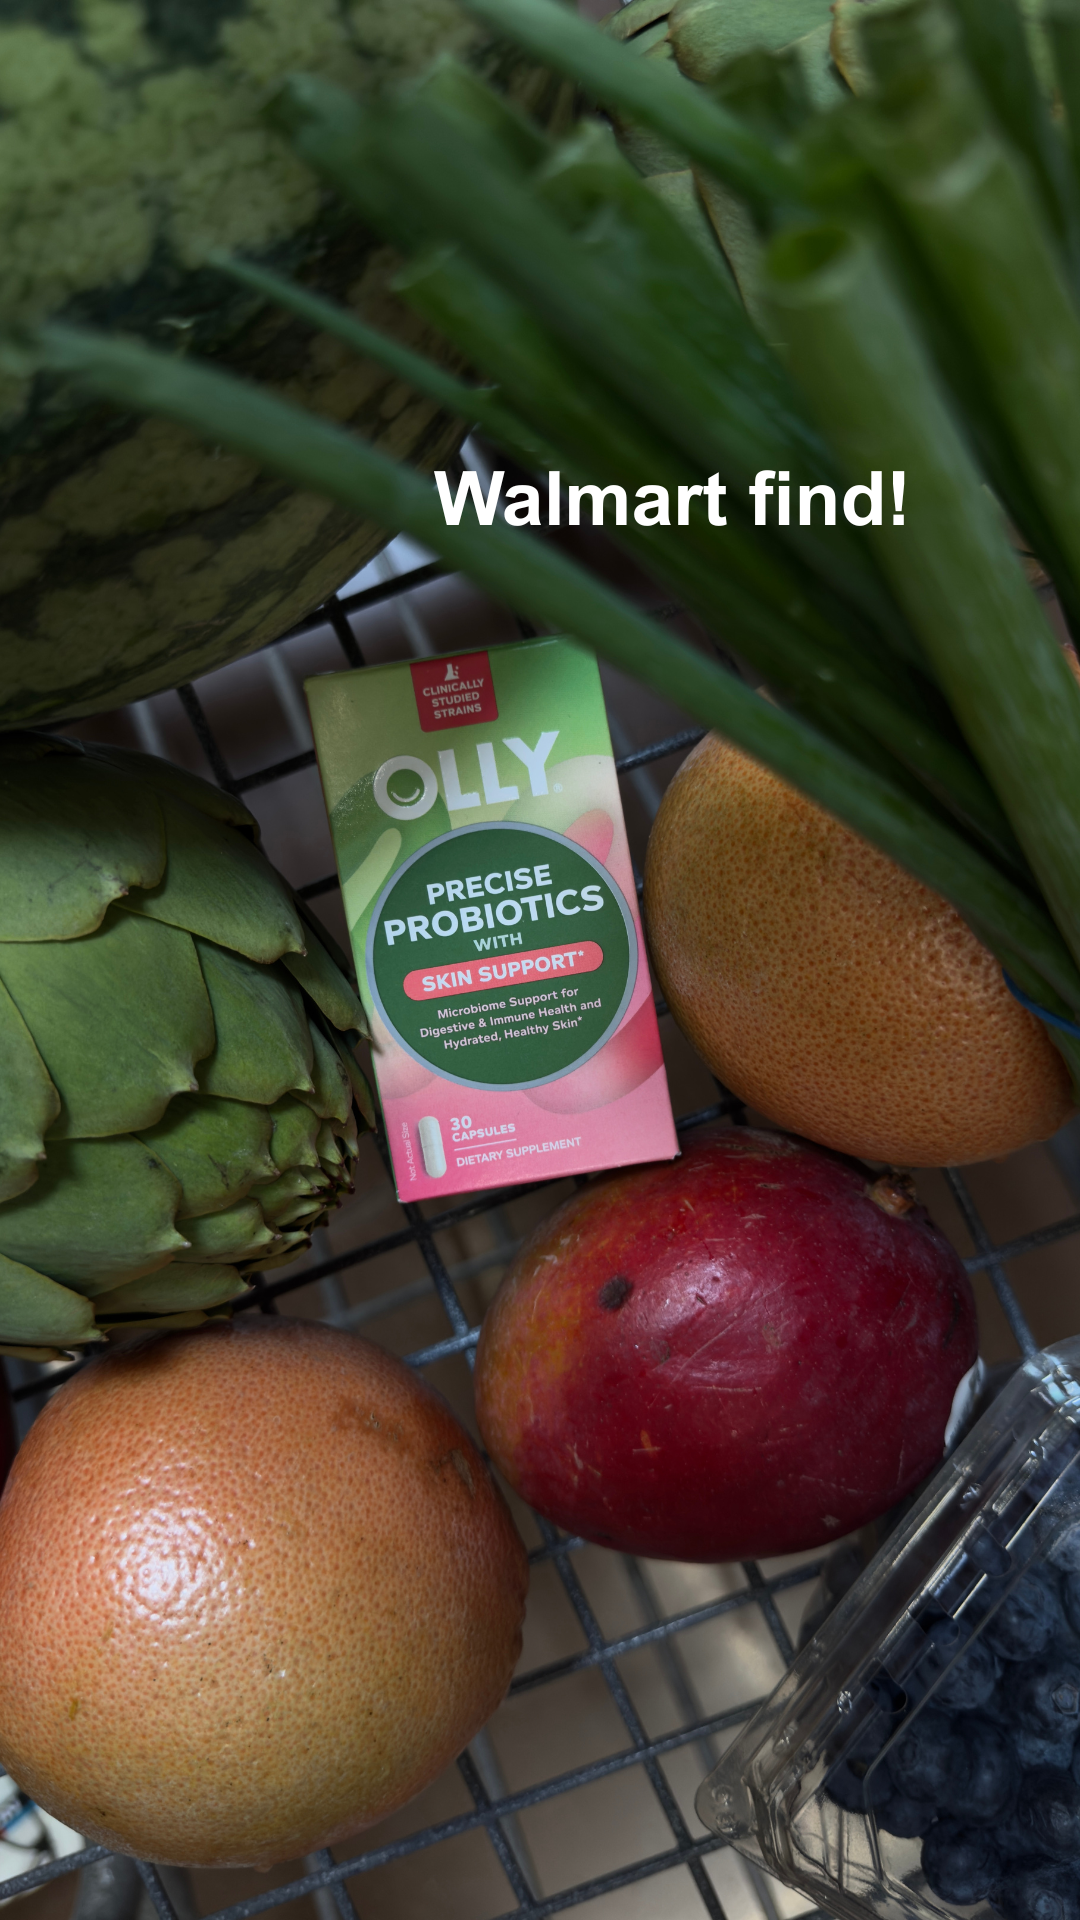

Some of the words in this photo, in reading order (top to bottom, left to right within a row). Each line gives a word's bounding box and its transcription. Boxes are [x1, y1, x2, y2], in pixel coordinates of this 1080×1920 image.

[422, 678, 484, 697] CLINICALLY
[431, 691, 480, 708] STUDIED
[433, 703, 482, 719] STRAINS
[373, 730, 560, 821] OLLY
[426, 863, 553, 905] PRECISE
[383, 884, 605, 946] PROBIOTICS
[473, 932, 523, 952] WITH
[421, 969, 473, 993] SKIN
[437, 1000, 507, 1020] Microbiome
[508, 989, 558, 1011] Support
[560, 987, 579, 999] for
[419, 1020, 476, 1040] Digestive
[478, 1018, 487, 1028] &
[489, 1010, 536, 1027] Immune
[538, 1003, 577, 1018] Health
[580, 998, 602, 1011] and
[443, 1030, 503, 1050] Hydrated,
[503, 1023, 550, 1041] Healthy
[401, 1121, 410, 1140] Size
[450, 1115, 472, 1131] 30
[452, 1123, 516, 1142] CAPSULES
[404, 1141, 416, 1166] Actual
[456, 1149, 503, 1167] DIETARY
[506, 1136, 582, 1159] SUPPLEMENT
[409, 1167, 417, 1181] Not
